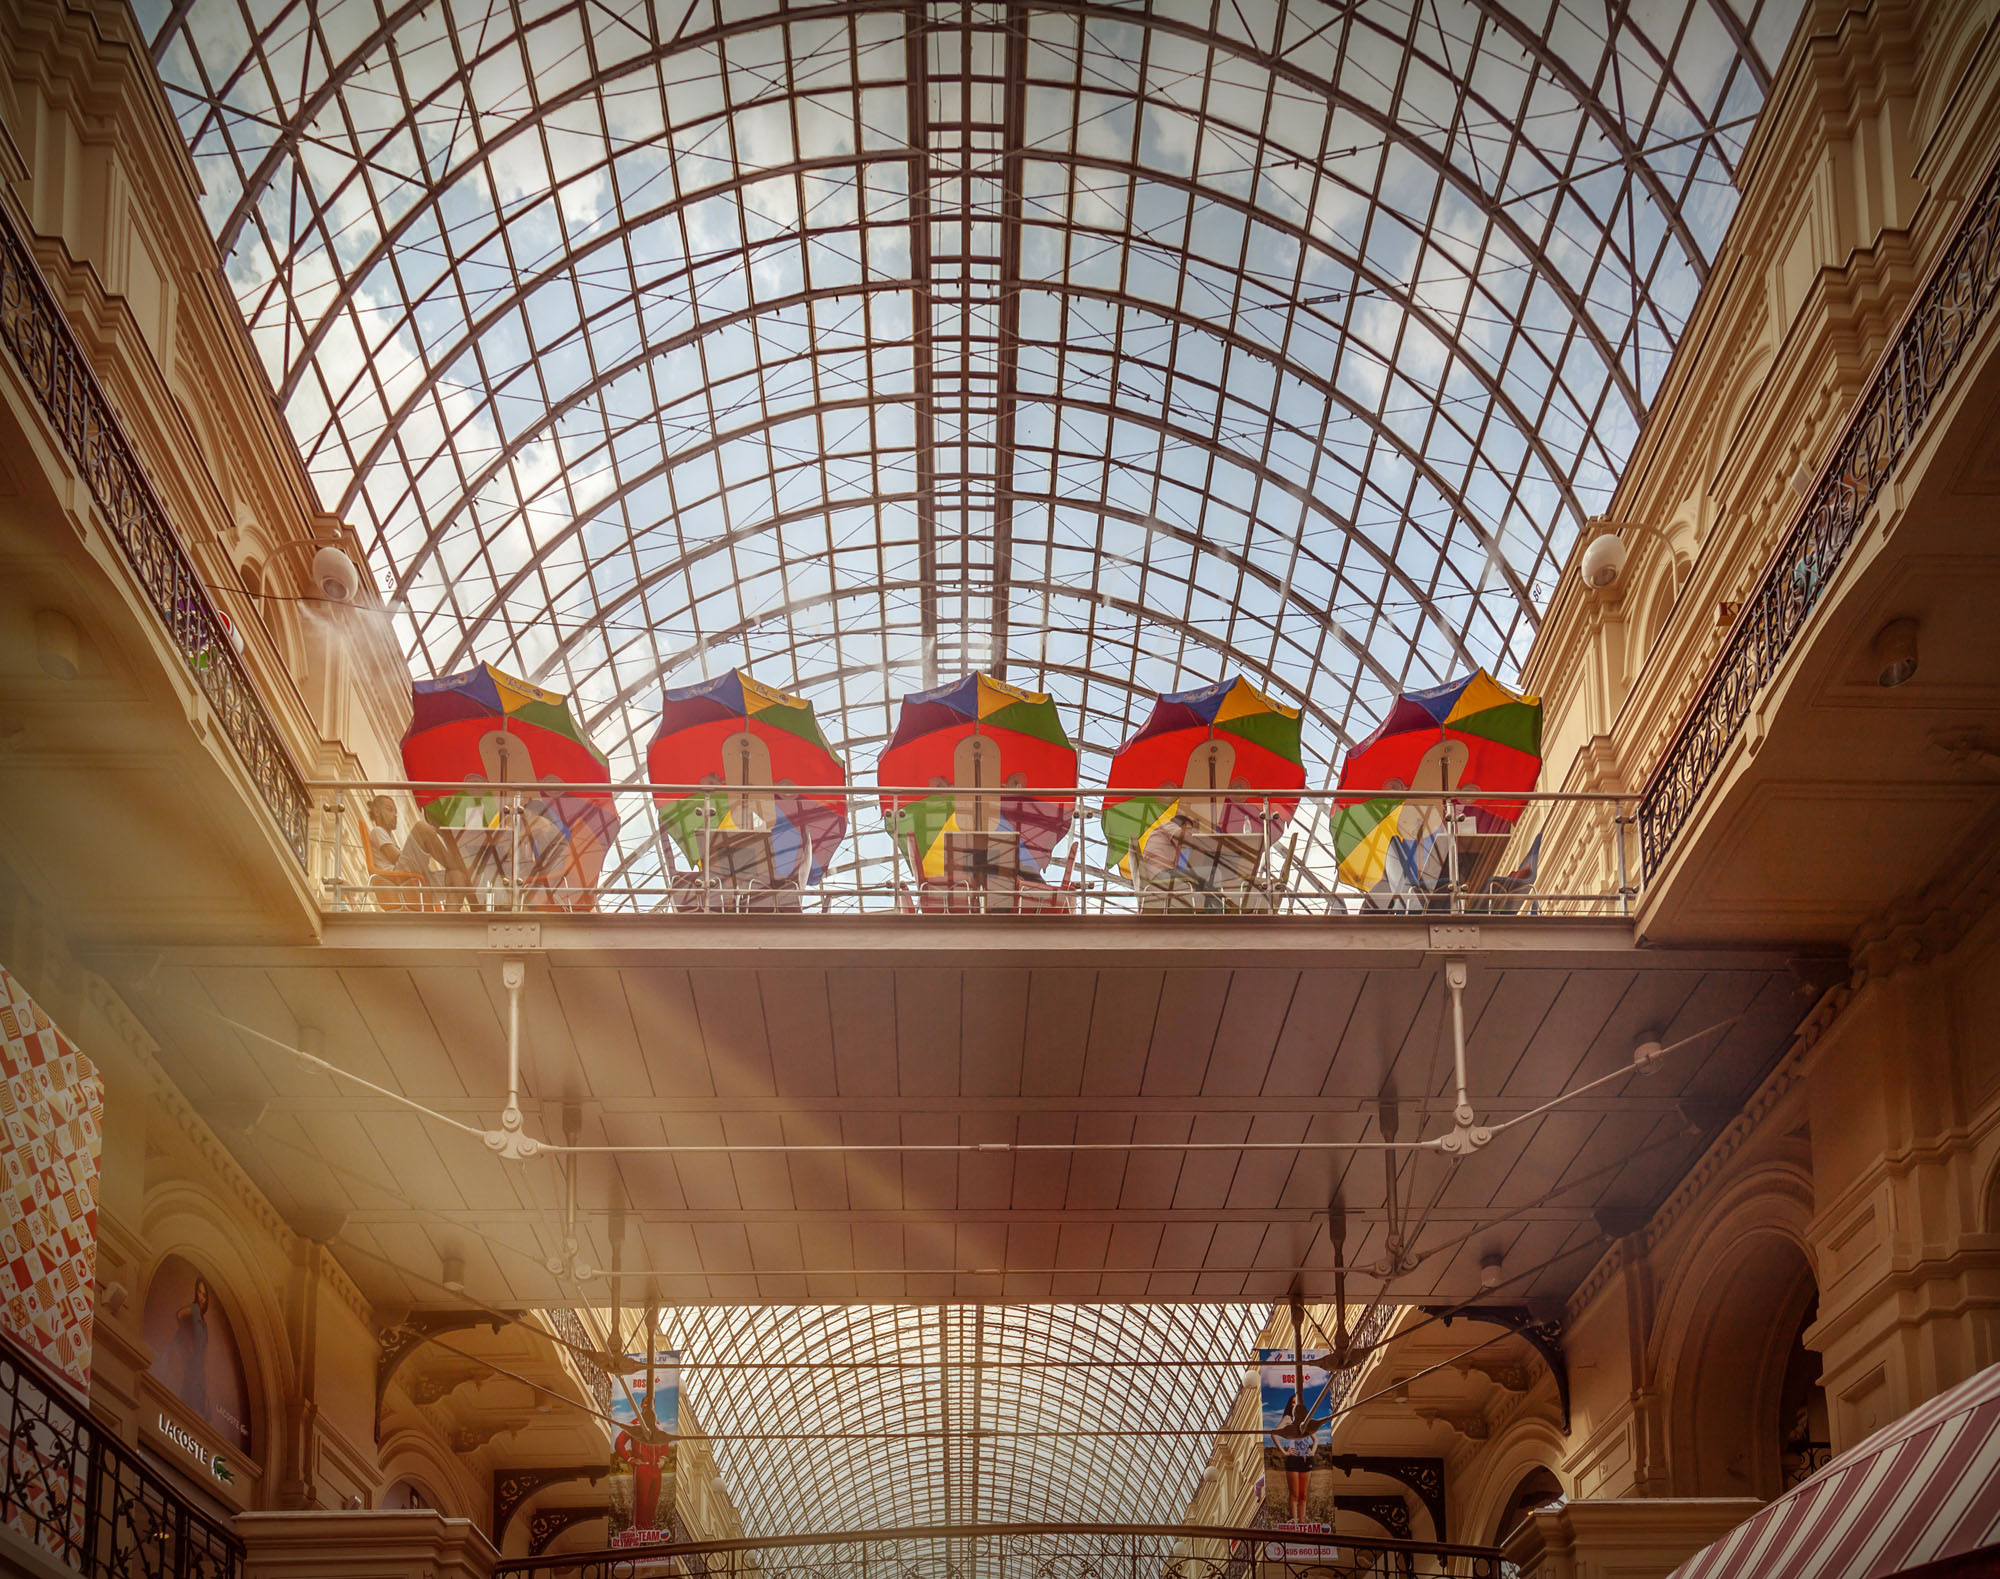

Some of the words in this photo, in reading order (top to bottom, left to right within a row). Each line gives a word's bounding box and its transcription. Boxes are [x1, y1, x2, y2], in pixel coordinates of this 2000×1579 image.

[159, 1413, 208, 1465] LACOSTE
[1298, 1522, 1320, 1533] TEAM
[638, 1530, 660, 1542] TEAM
